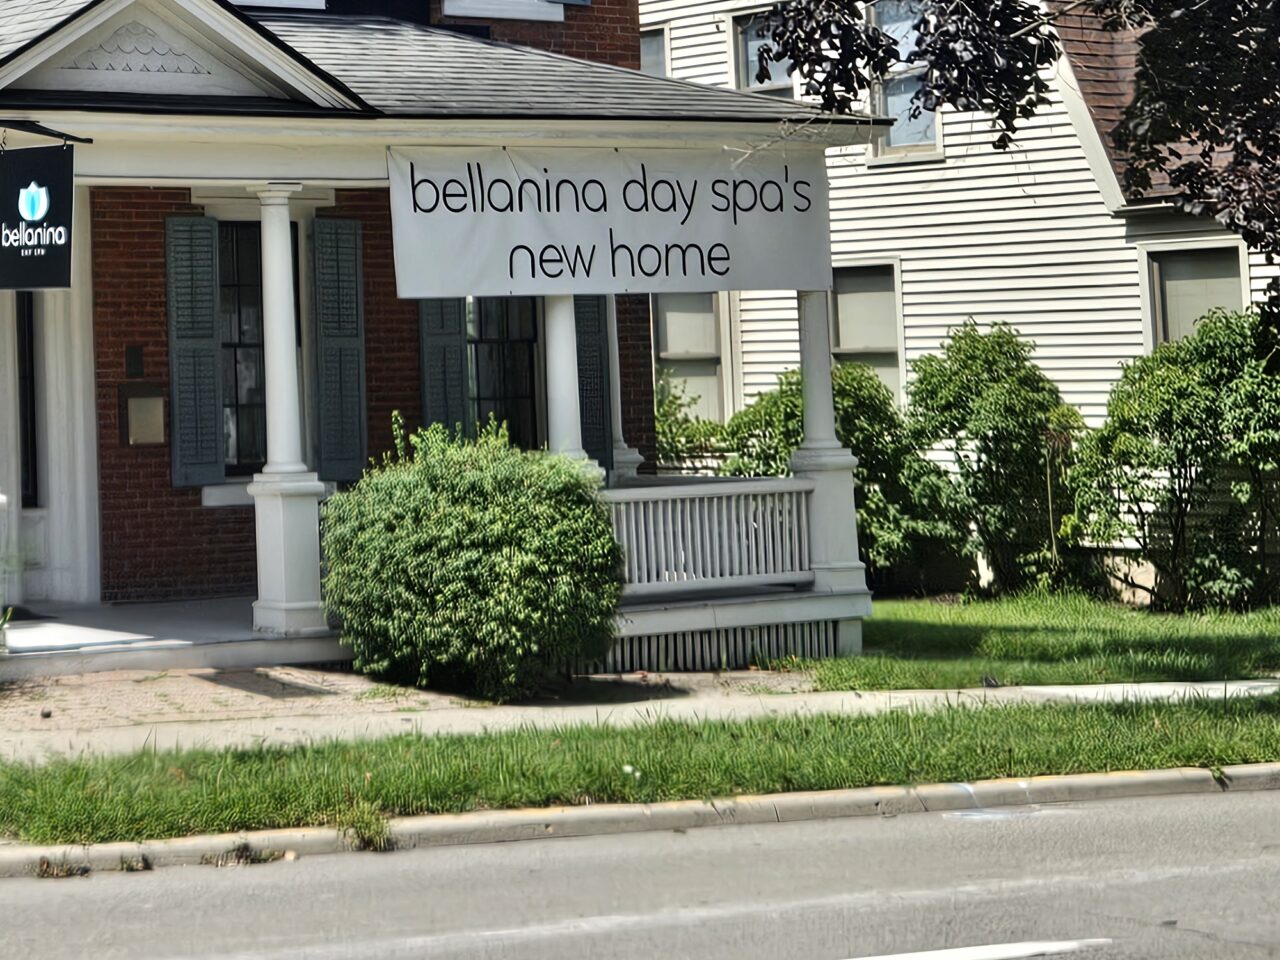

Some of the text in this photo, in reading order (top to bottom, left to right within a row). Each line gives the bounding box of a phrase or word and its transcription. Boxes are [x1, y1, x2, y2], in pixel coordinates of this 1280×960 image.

[409, 161, 812, 226] bellanina day spa's
[1, 221, 67, 247] bellanina
[508, 227, 731, 279] new home
